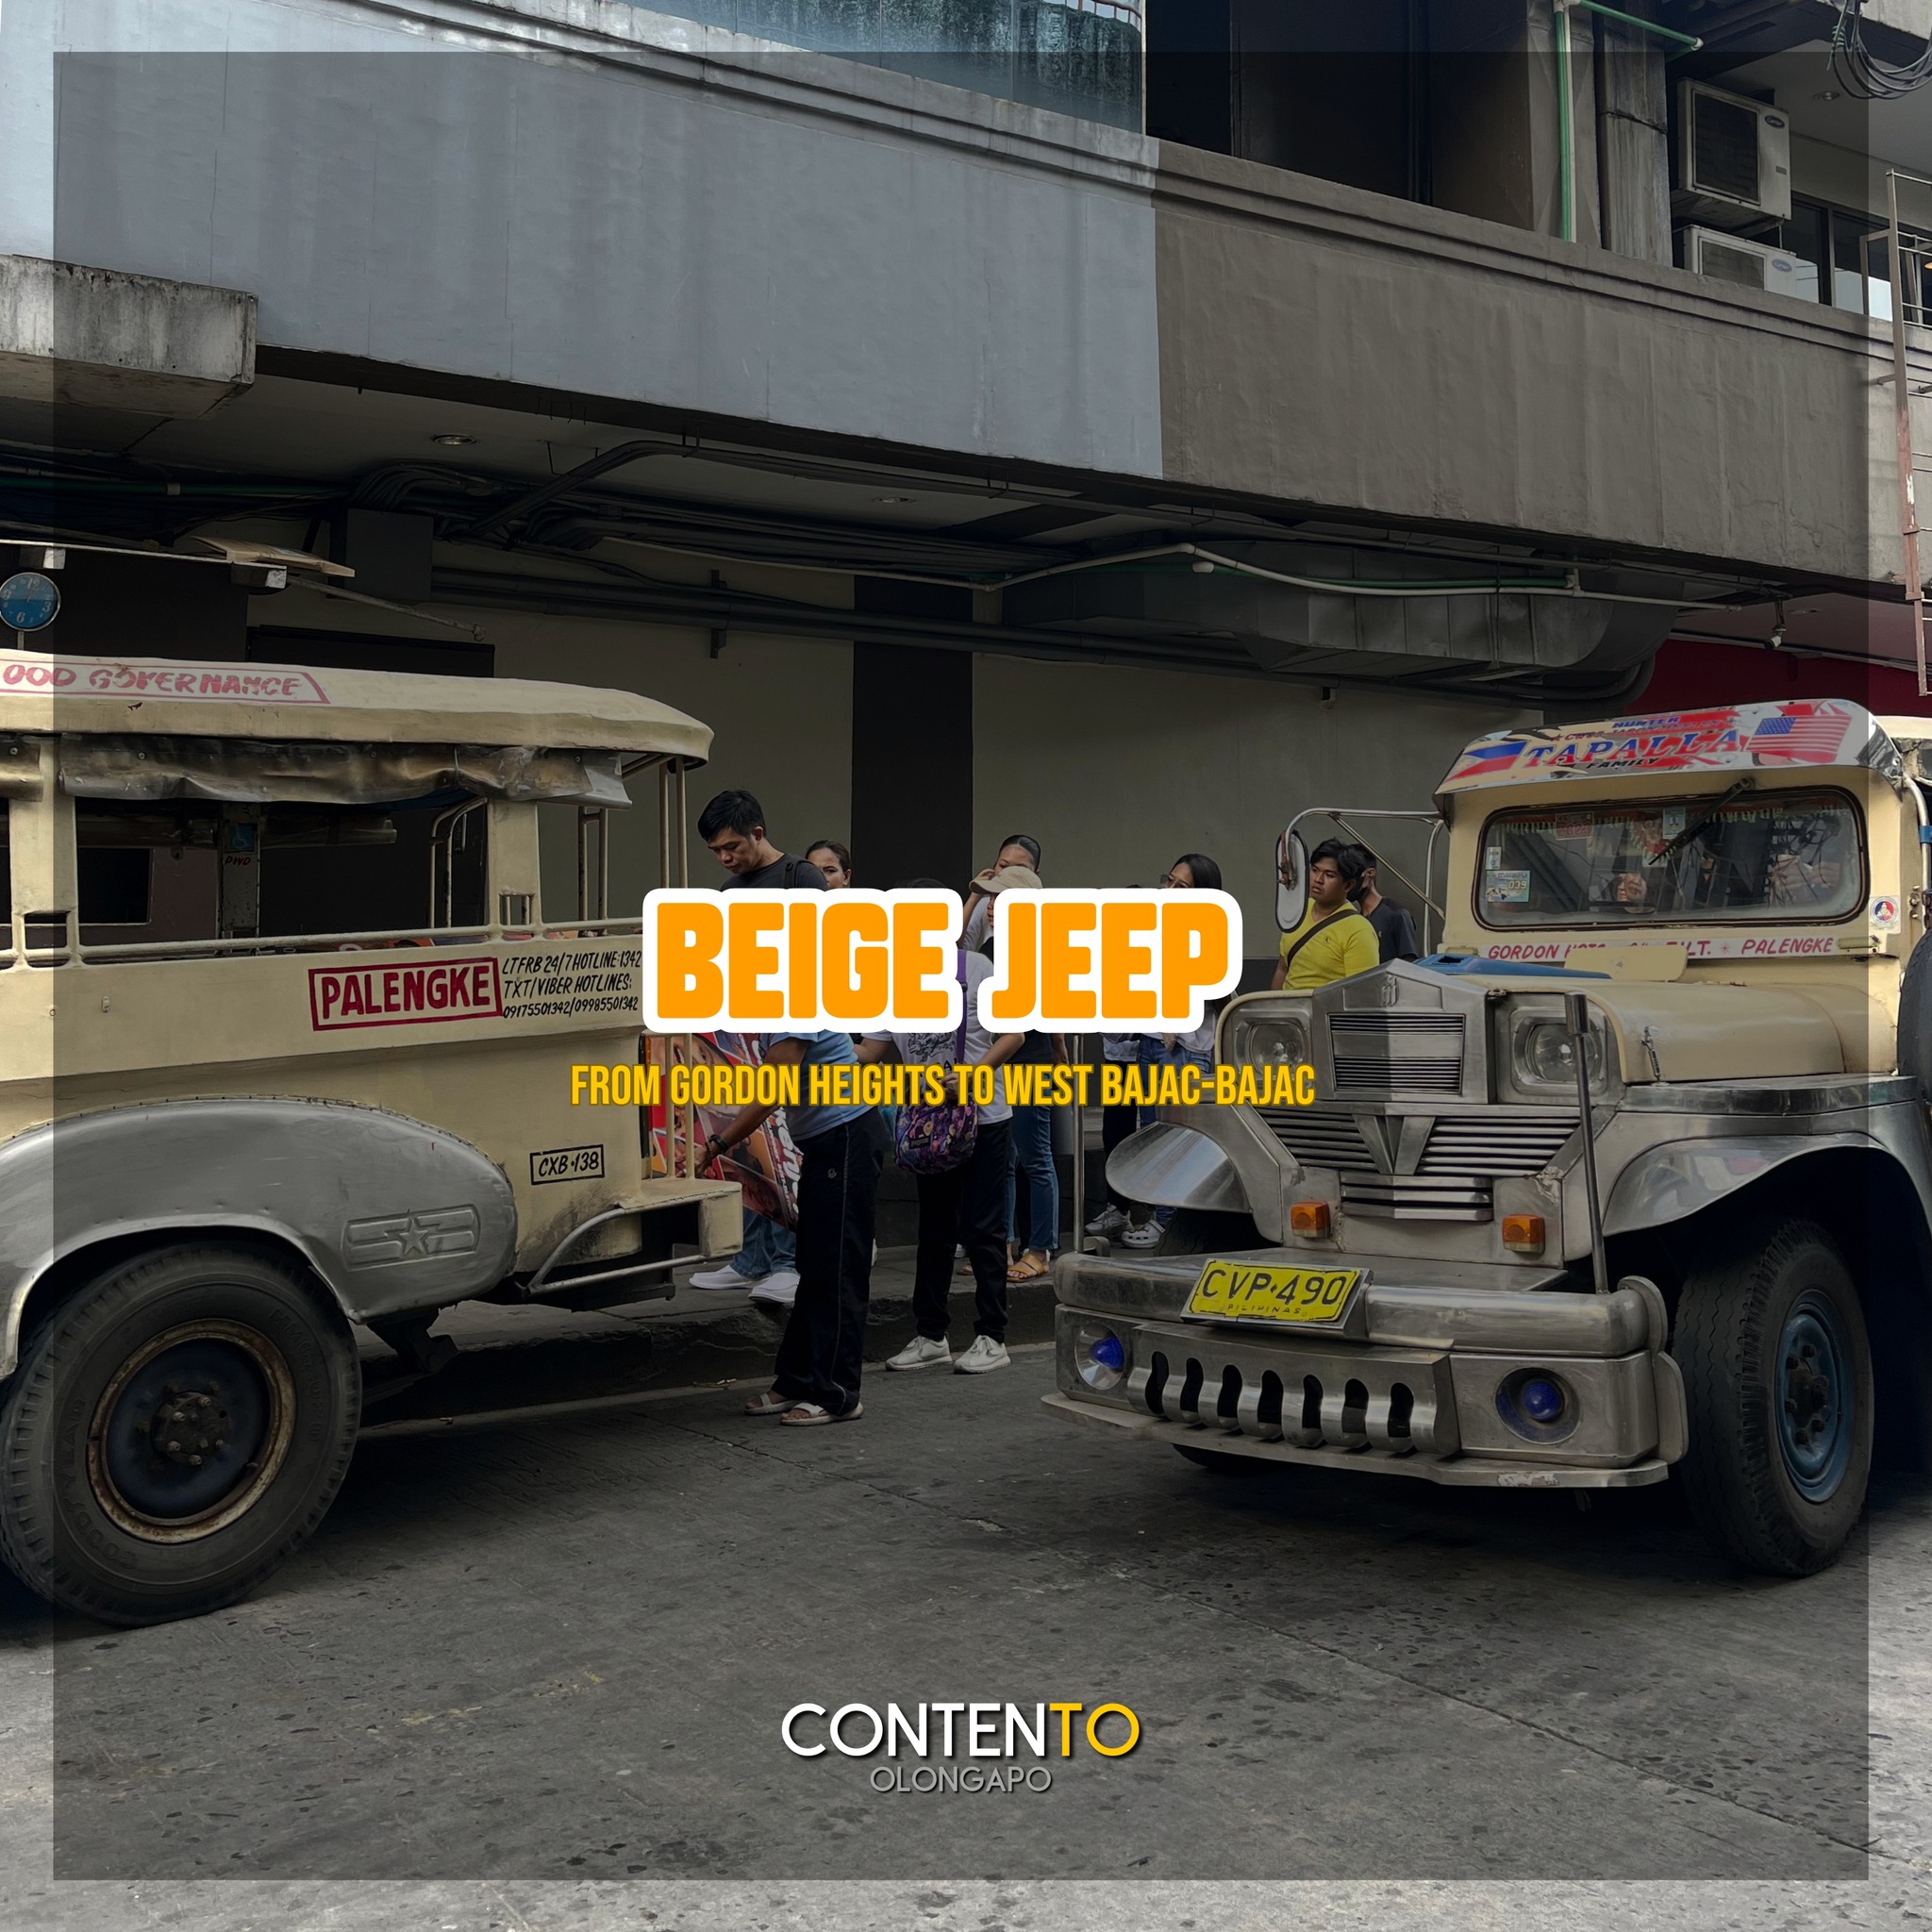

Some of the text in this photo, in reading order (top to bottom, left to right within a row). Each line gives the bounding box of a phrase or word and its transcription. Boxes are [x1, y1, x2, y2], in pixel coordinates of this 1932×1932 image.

[89, 667, 302, 697] GOVERNANCE
[1524, 729, 1740, 768] TAPALLA
[1585, 758, 1660, 769] FAMILY
[225, 855, 251, 866] PWD
[1488, 944, 1560, 960] GORDON
[1741, 938, 1835, 955] PALENGKE
[502, 956, 543, 974] LTFRB
[322, 964, 491, 1020] PALENGKE
[504, 973, 632, 999] TXT/VIBER HOTLINES:
